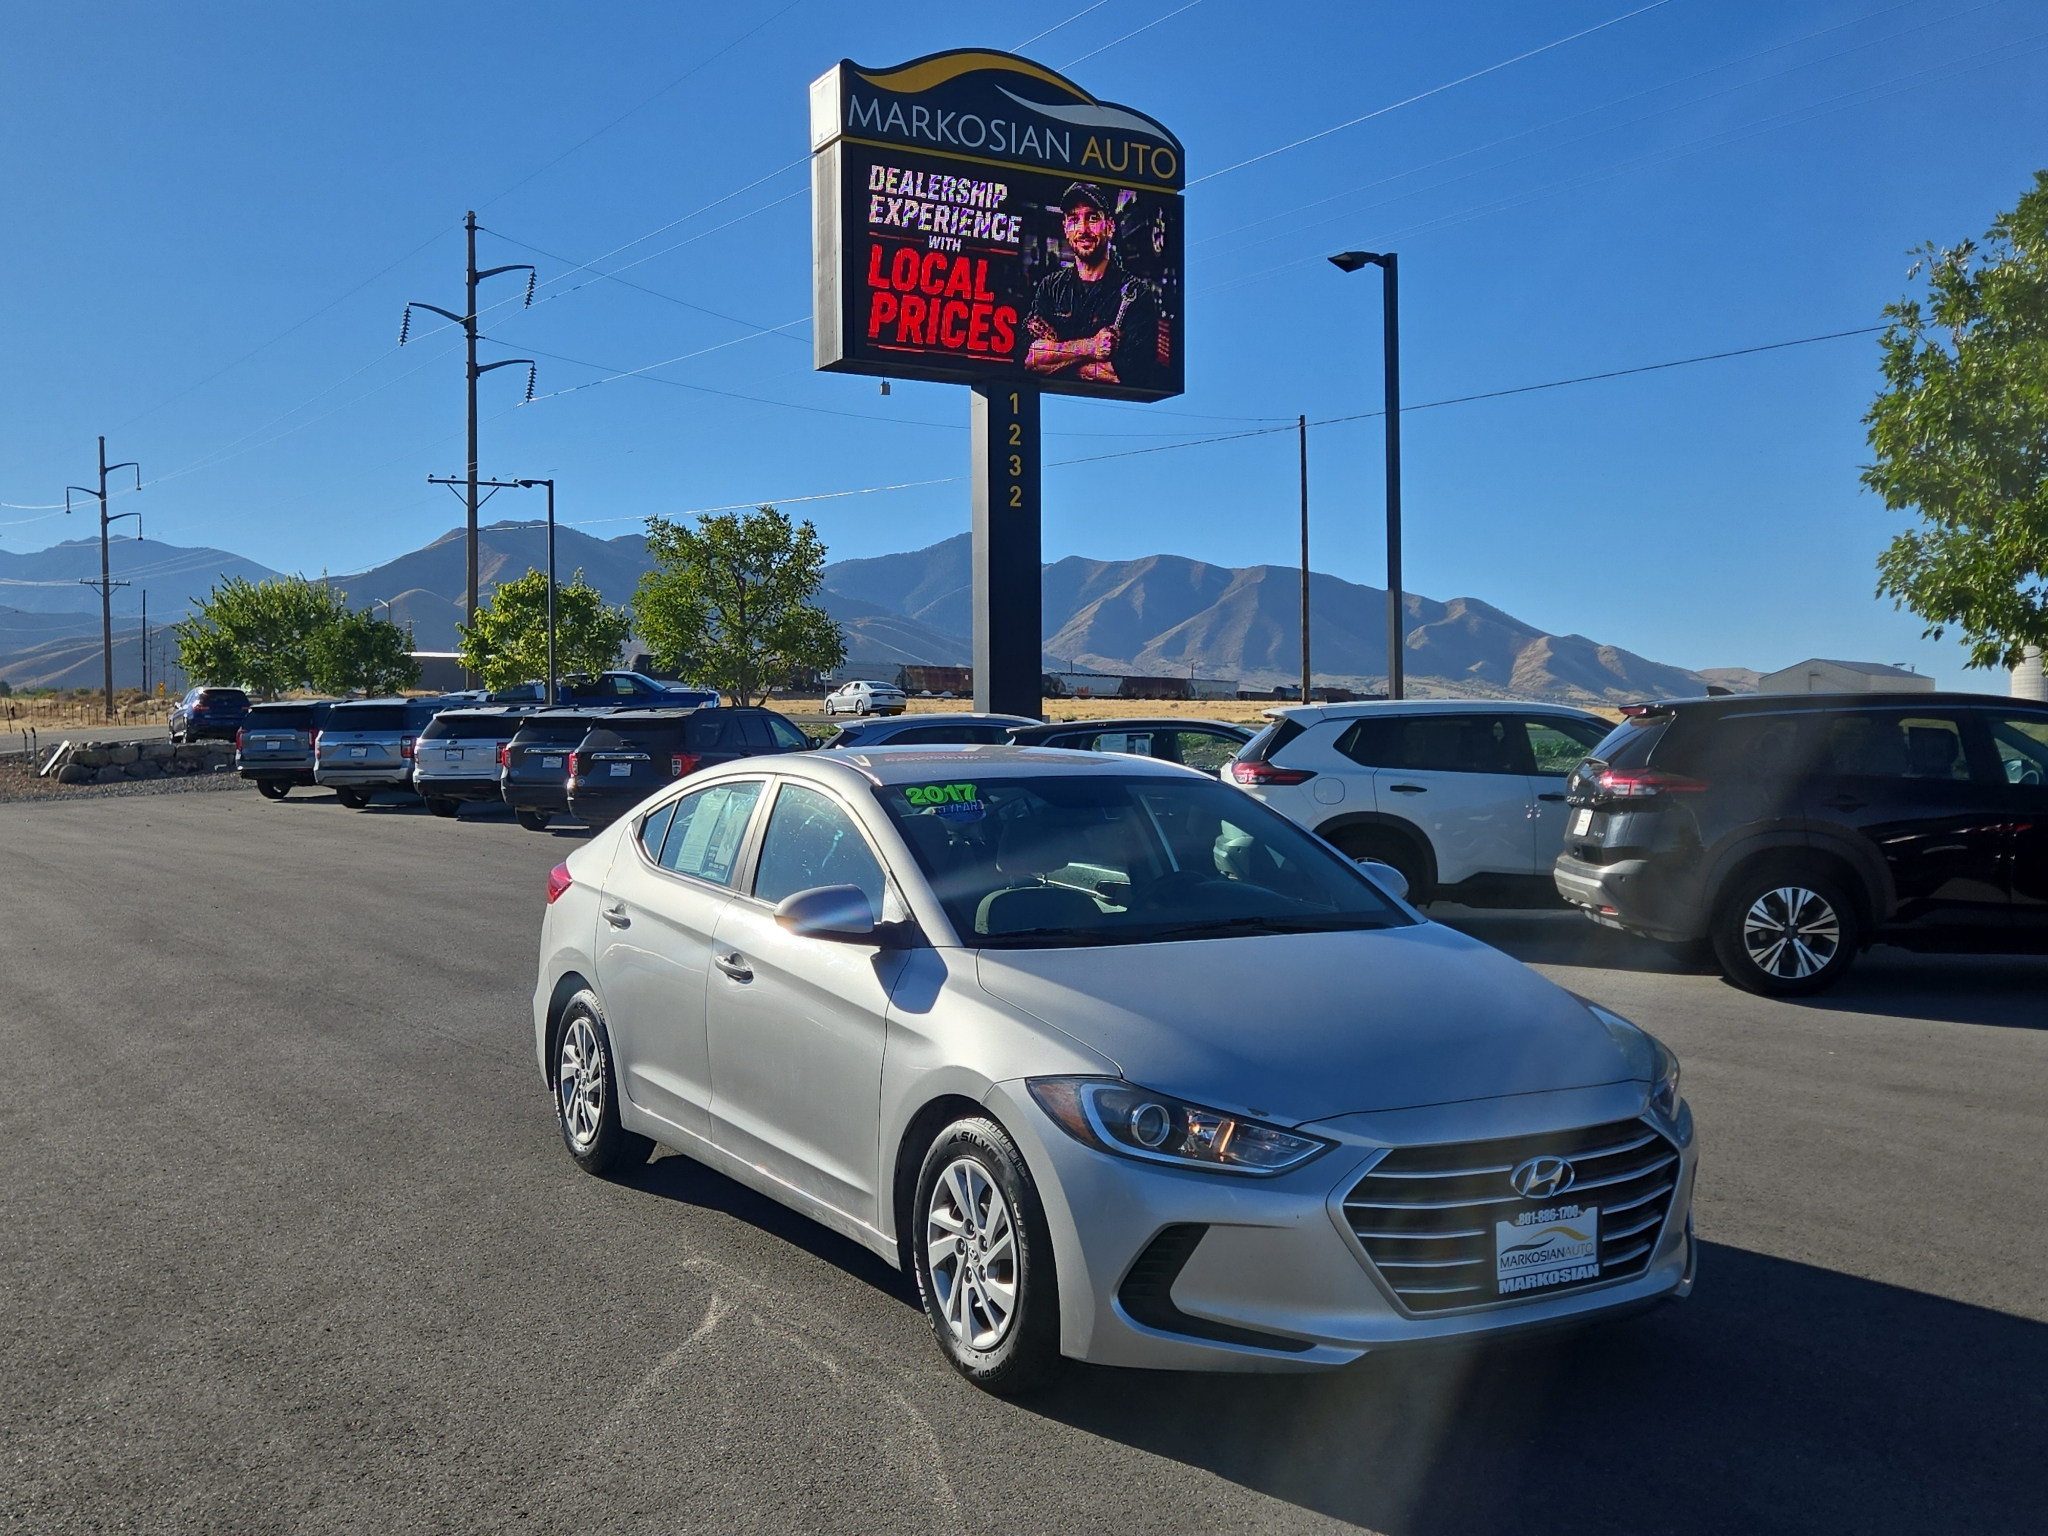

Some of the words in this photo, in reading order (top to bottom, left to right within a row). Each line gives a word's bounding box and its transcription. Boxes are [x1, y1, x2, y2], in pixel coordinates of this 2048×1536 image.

[848, 94, 1070, 163] MARKOSIAN
[1081, 136, 1177, 179] AUTO
[868, 164, 1008, 209] DEALERSHIP
[868, 194, 1023, 244] EXPERIENCE
[928, 235, 962, 253] WITH
[867, 243, 995, 303] LOCAL
[867, 291, 1018, 354] PRICES
[905, 783, 977, 804] 2017
[1499, 1263, 1600, 1294] MARKOSIAN
